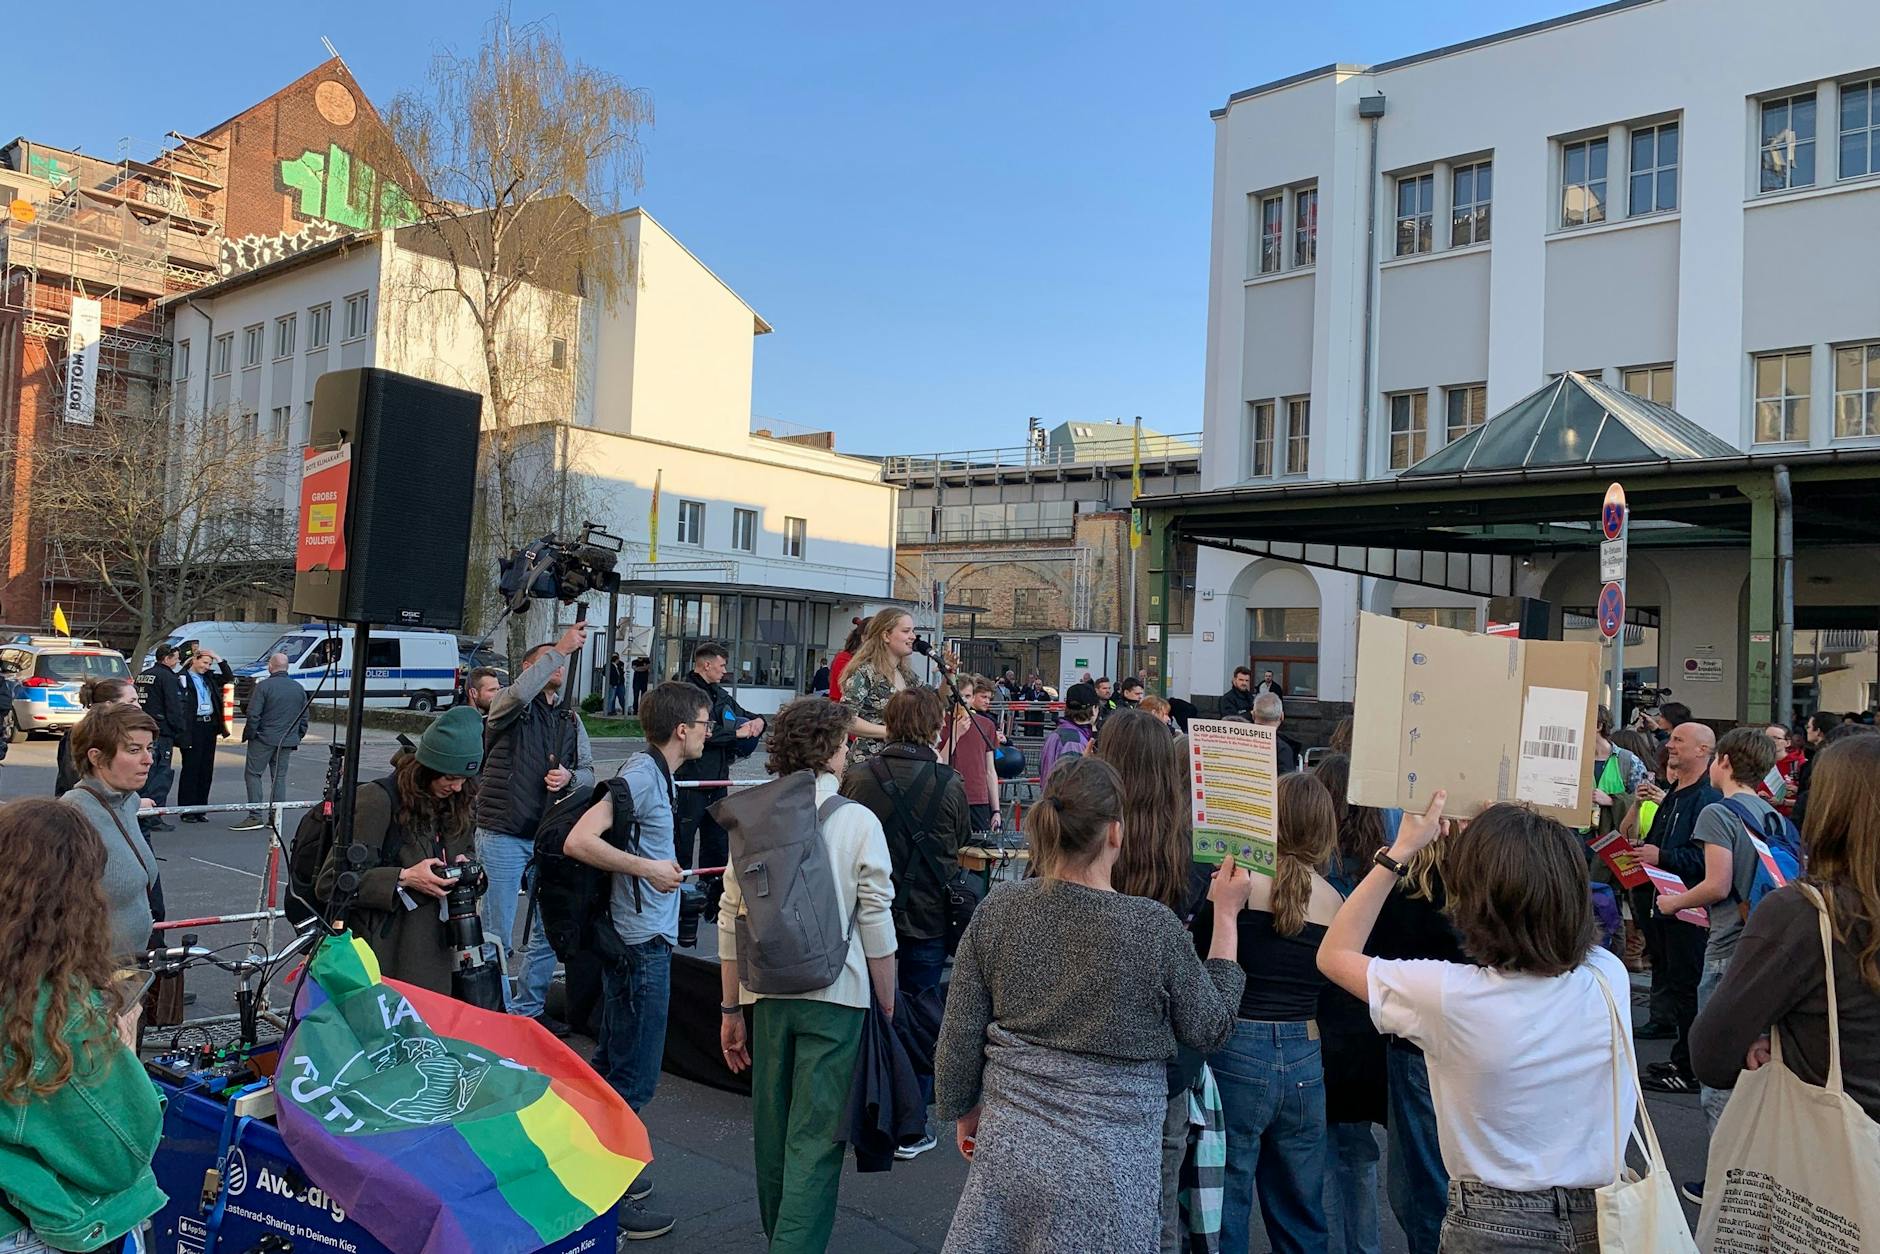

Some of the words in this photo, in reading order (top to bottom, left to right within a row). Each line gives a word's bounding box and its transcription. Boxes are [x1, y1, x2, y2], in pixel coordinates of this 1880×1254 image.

[69, 353, 85, 410] BOTTOM
[311, 491, 338, 502] GROBES
[305, 535, 336, 546] FOULSPIEL
[365, 669, 390, 678] OLIZEI
[1192, 724, 1227, 735] GROBES
[1229, 727, 1273, 740] FOULSPIEL!
[256, 1167, 345, 1223] Avoarg
[223, 1202, 296, 1235] Lastenrad-Sharing
[297, 1224, 305, 1237] in
[306, 1227, 338, 1248] Deinem
[339, 1237, 357, 1254] Kiez
